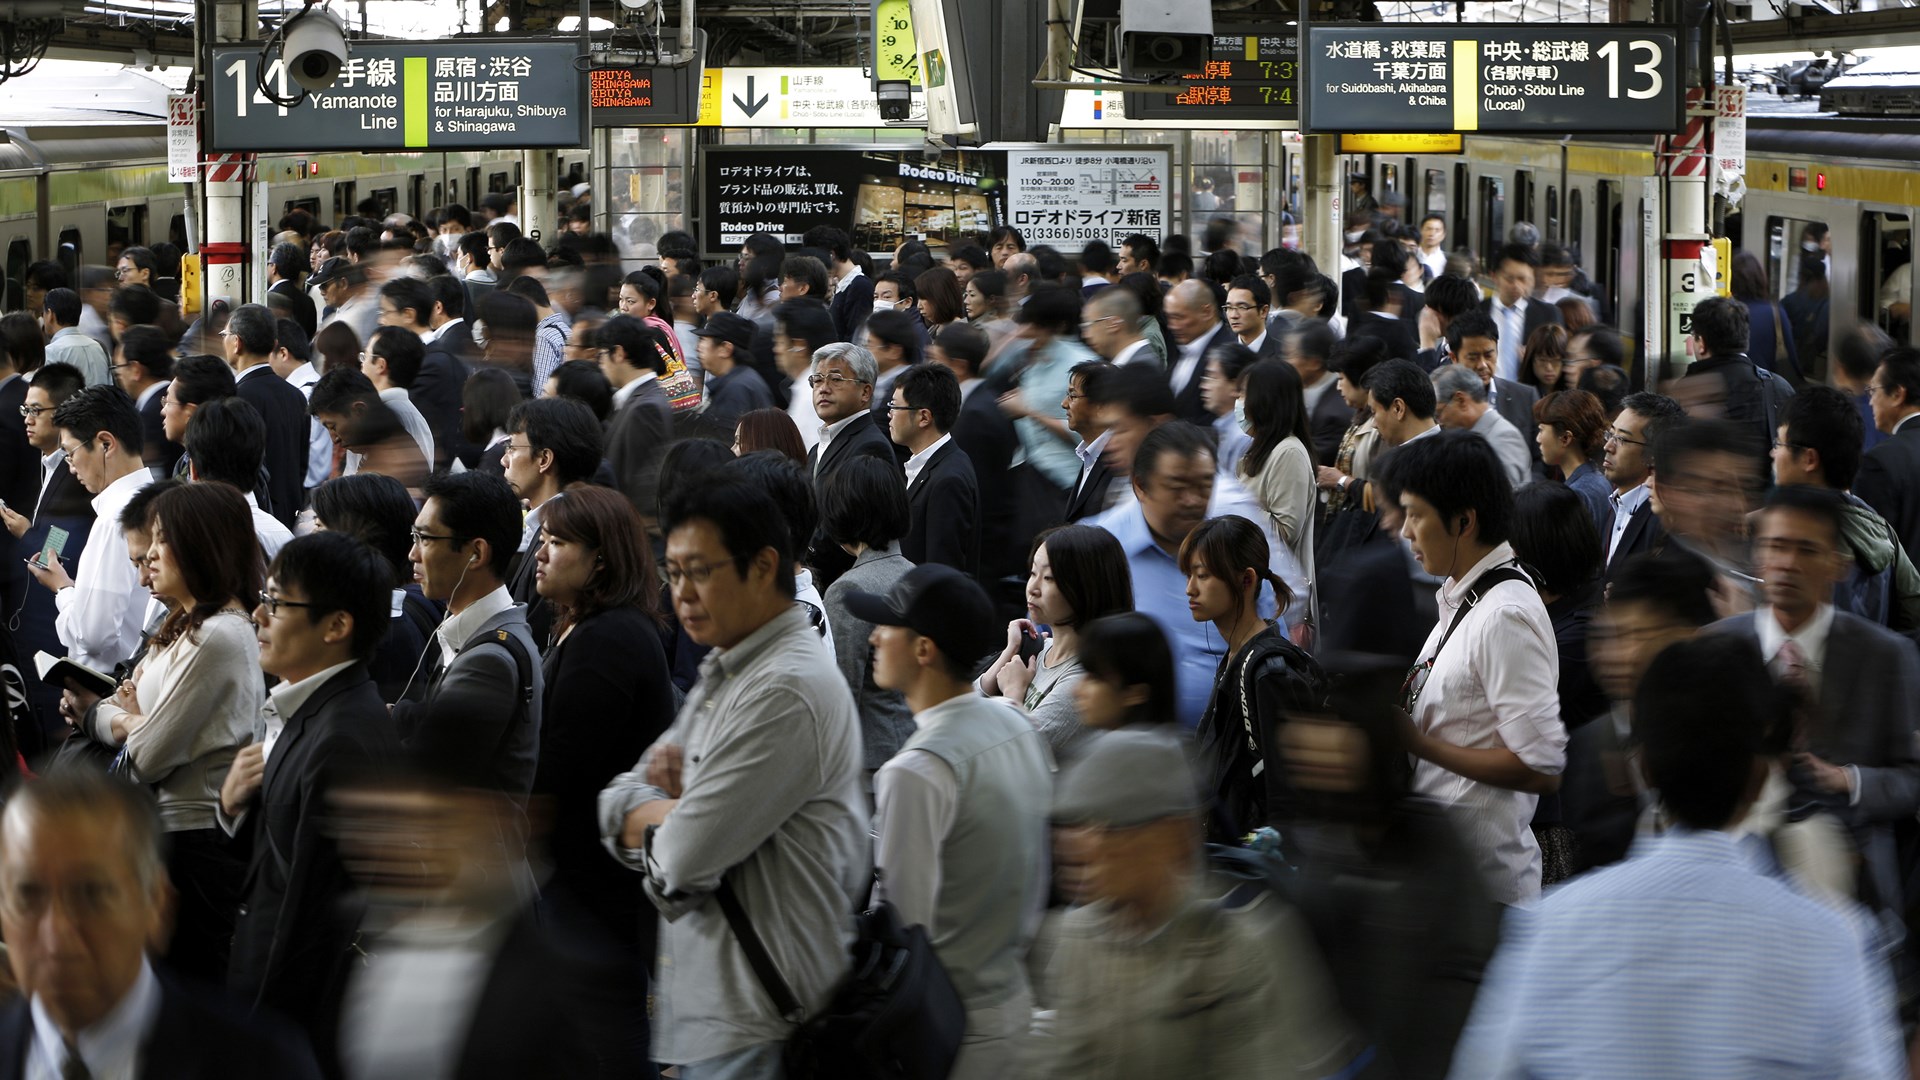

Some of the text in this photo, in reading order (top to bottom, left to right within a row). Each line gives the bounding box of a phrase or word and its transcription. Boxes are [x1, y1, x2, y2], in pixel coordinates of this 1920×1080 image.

[893, 20, 908, 30] 10
[886, 36, 896, 46] 9
[1325, 41, 1447, 59] 水道橋・秋葉原
[1483, 41, 1590, 62] 中央・総武線
[893, 54, 903, 64] 8
[330, 58, 397, 87] 手線
[434, 57, 532, 78] 原宿・渋谷
[910, 66, 919, 76] 7
[1259, 61, 1299, 79] 7:3
[1372, 62, 1447, 80] 千葉方面
[1596, 40, 1663, 100] 13
[592, 79, 650, 88] SHINAGAWA
[793, 75, 824, 86] 山手線
[225, 59, 296, 117] 14
[434, 81, 519, 102] 品川方面
[1326, 83, 1447, 94] for Suidōbashi, Akihabara
[1559, 84, 1585, 96] Line
[309, 93, 397, 109] Yamanote
[592, 97, 651, 107] SHINAGAWA
[1408, 95, 1447, 106] & Chiba
[1484, 98, 1526, 112] (Local)
[434, 104, 567, 119] for Harajuku, Shibuya
[361, 113, 397, 130] Line
[434, 121, 516, 134] & Shinagawa
[1020, 157, 1072, 165] JR新宿西口より
[1075, 157, 1102, 165] 徒歩8分
[720, 165, 812, 177] ロデオドライブは、
[899, 163, 977, 186] Rodeo Drive
[720, 183, 844, 196] ブランド品の販売、買取、
[719, 201, 840, 214] 質預かりの専門店です。
[1015, 209, 1161, 226] ロデオドライブ新宿
[720, 222, 784, 232] Rodeo Drive
[1240, 649, 1254, 734] DUNLOP
